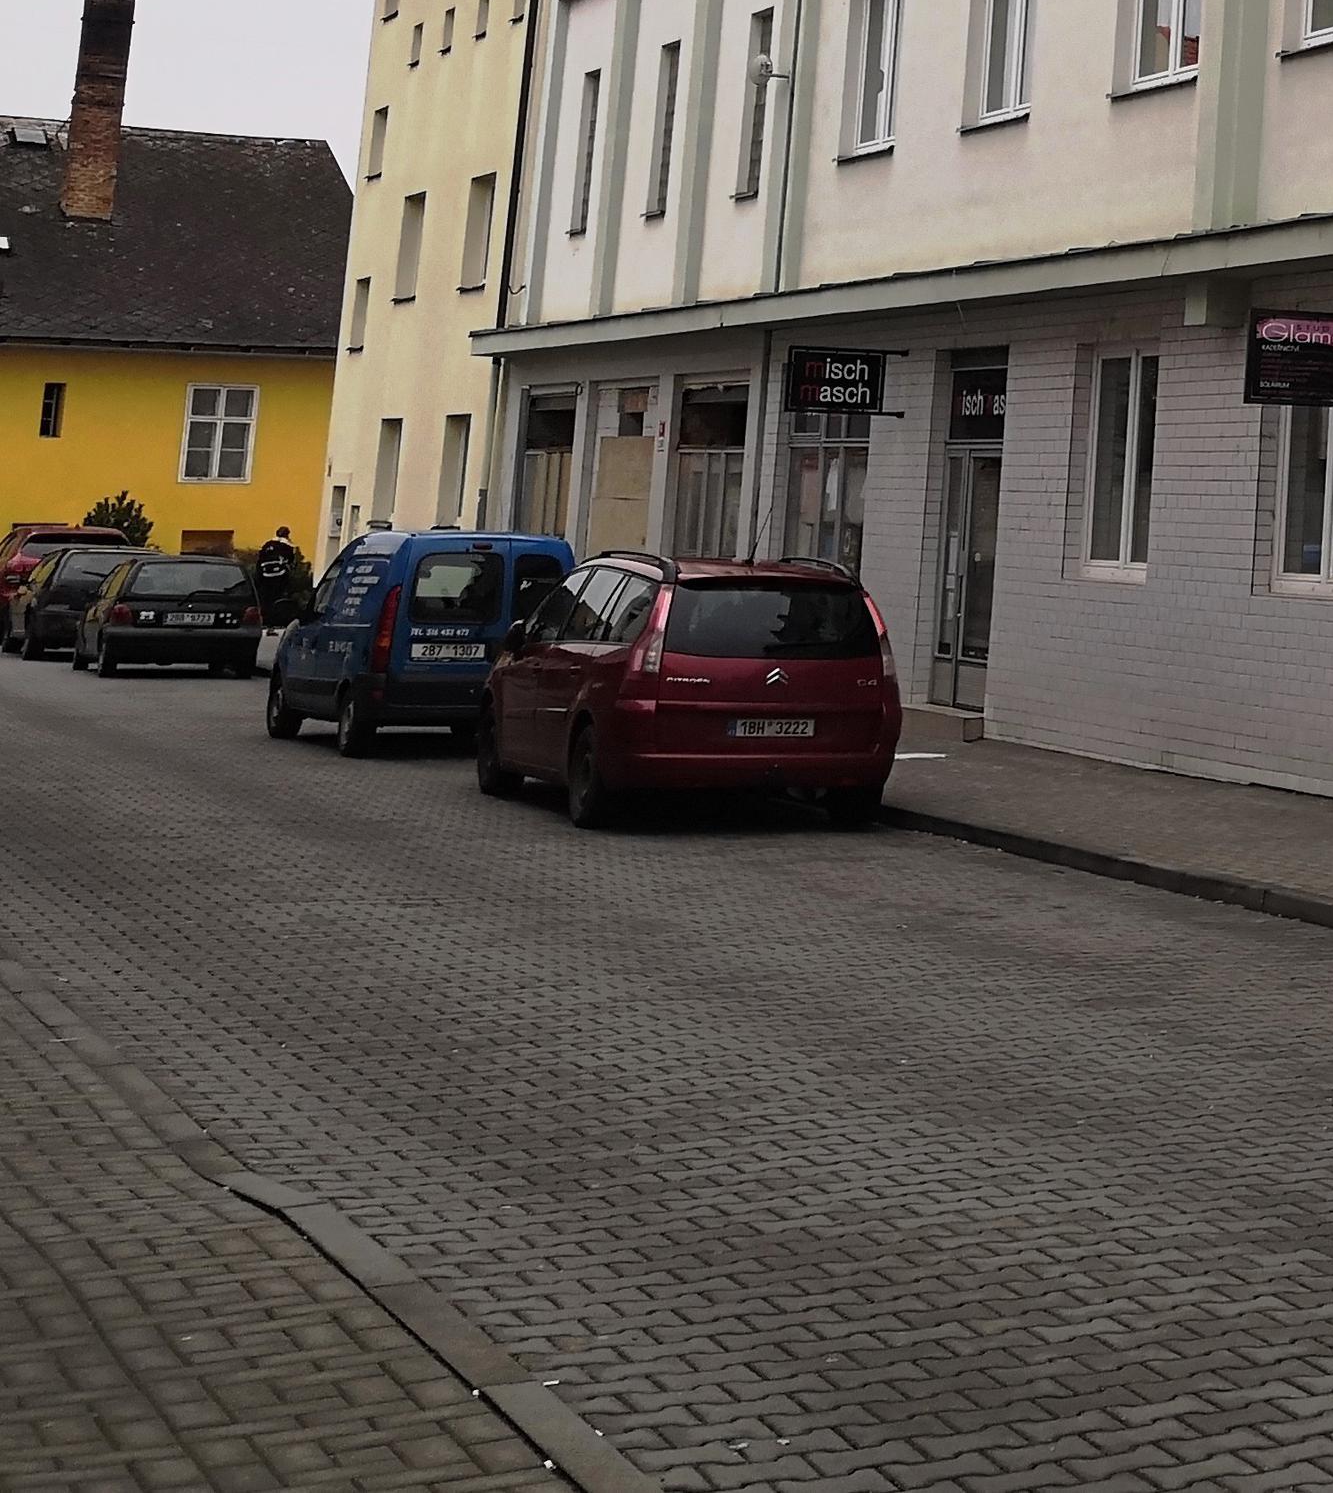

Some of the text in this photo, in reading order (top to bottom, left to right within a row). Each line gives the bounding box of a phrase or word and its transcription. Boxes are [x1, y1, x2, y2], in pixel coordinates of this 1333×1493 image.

[804, 357, 869, 381] misch
[800, 382, 870, 404] masch
[452, 645, 480, 657] 1307
[740, 721, 809, 735] 1BH 3222
